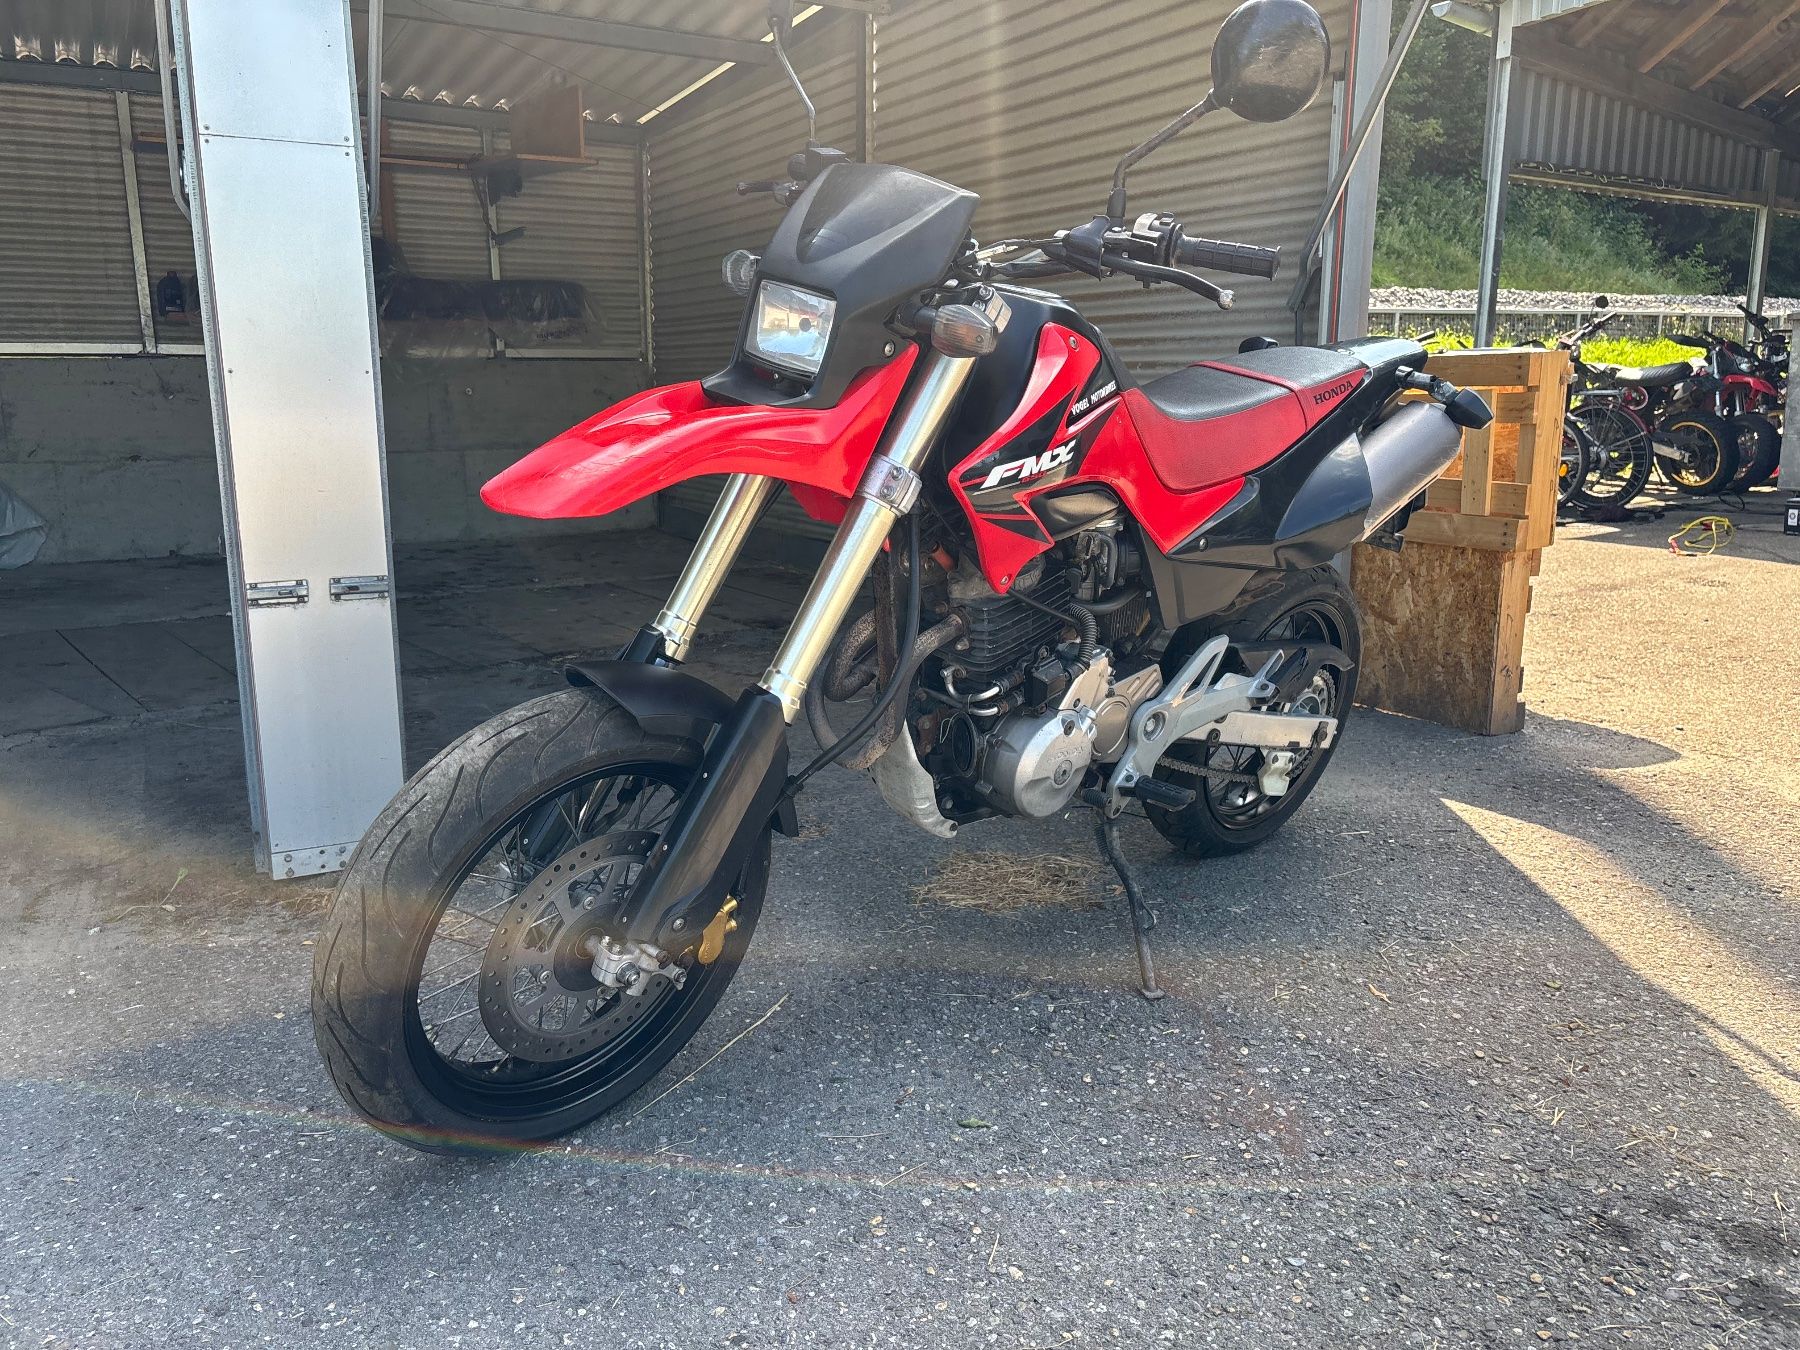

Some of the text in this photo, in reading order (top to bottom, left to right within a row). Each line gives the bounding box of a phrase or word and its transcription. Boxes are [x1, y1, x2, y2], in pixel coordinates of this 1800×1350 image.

[1313, 380, 1354, 405] HONDA
[1071, 397, 1090, 416] VOGEL
[980, 439, 1077, 490] FMX
